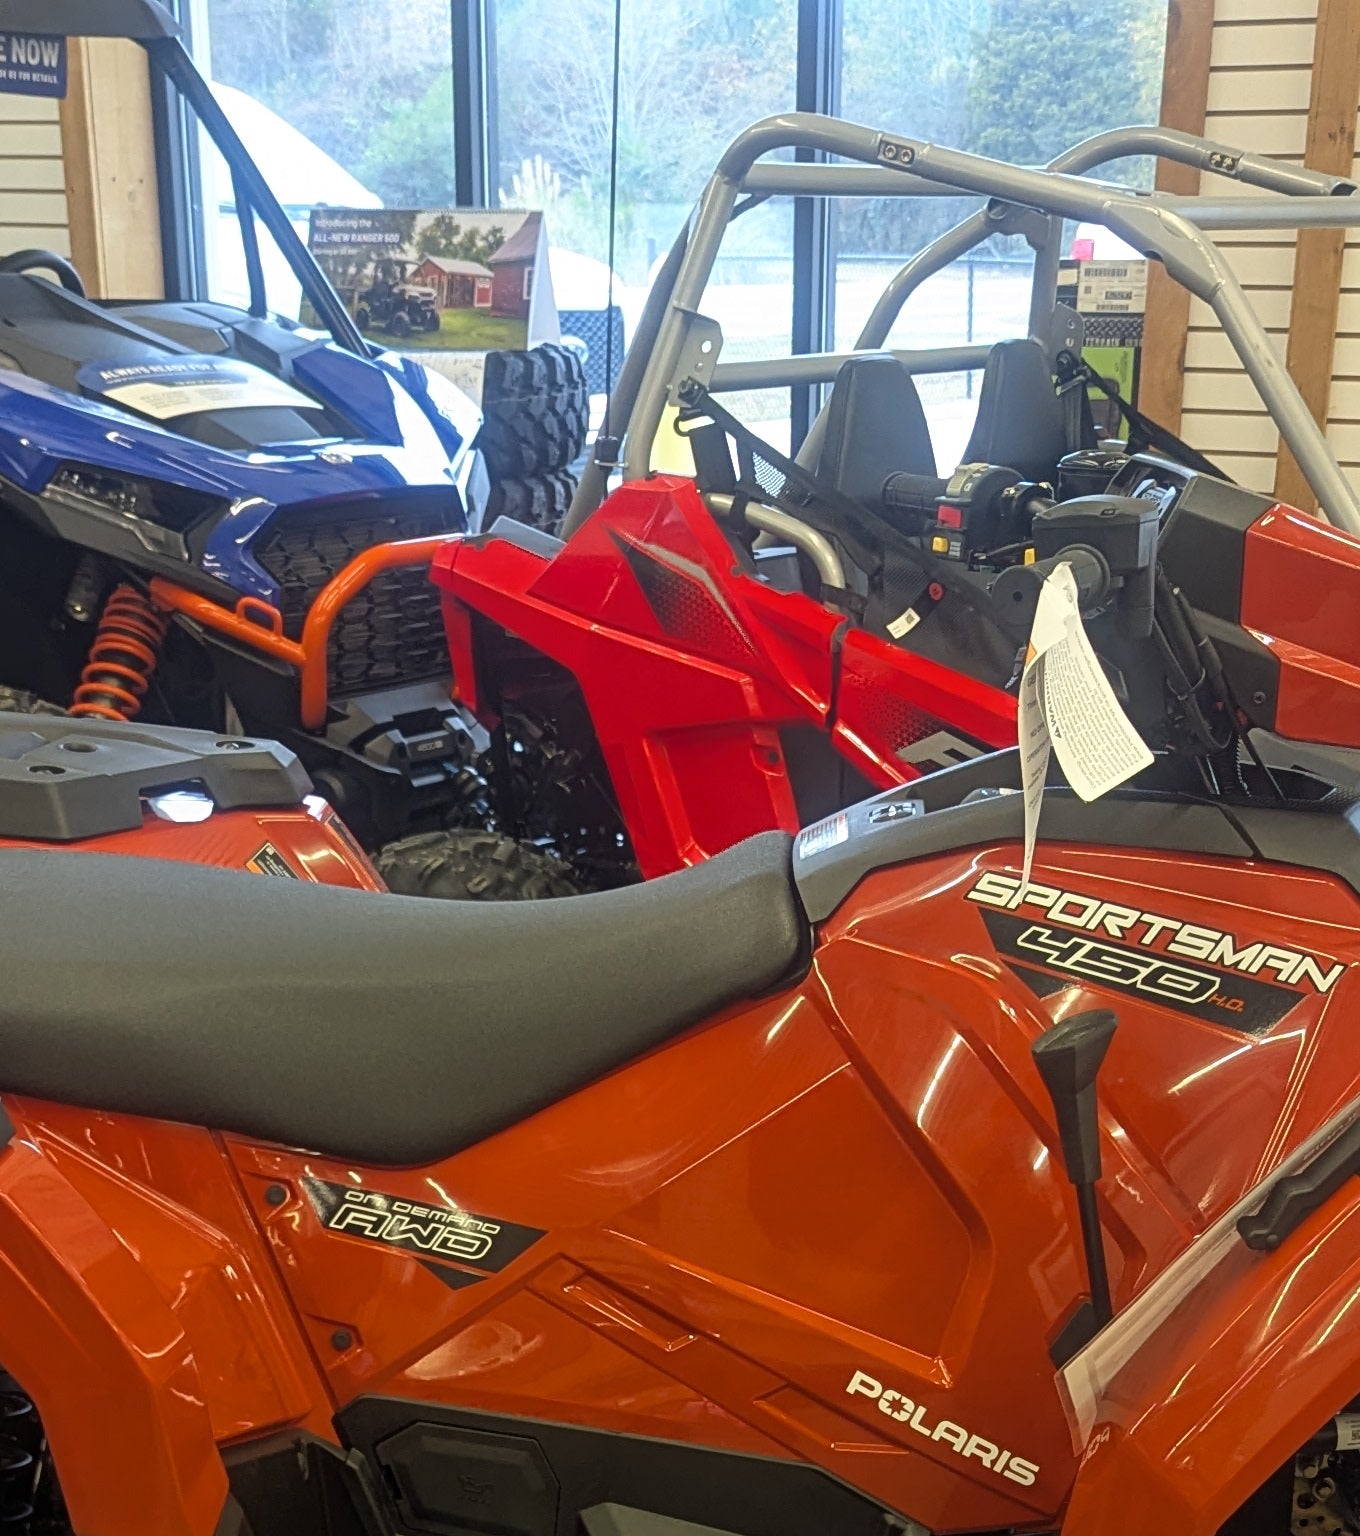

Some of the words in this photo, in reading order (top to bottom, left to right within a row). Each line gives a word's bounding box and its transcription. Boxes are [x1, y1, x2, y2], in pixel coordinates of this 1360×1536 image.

[11, 36, 60, 69] NOW
[100, 365, 150, 380] ALWAYS
[966, 872, 1344, 993] SPORTSMAN
[1017, 926, 1221, 1004] 450
[329, 1203, 493, 1260] AWD
[344, 1190, 388, 1212] ON
[391, 1201, 501, 1235] DEMAND
[845, 1370, 1040, 1487] POLARIS
